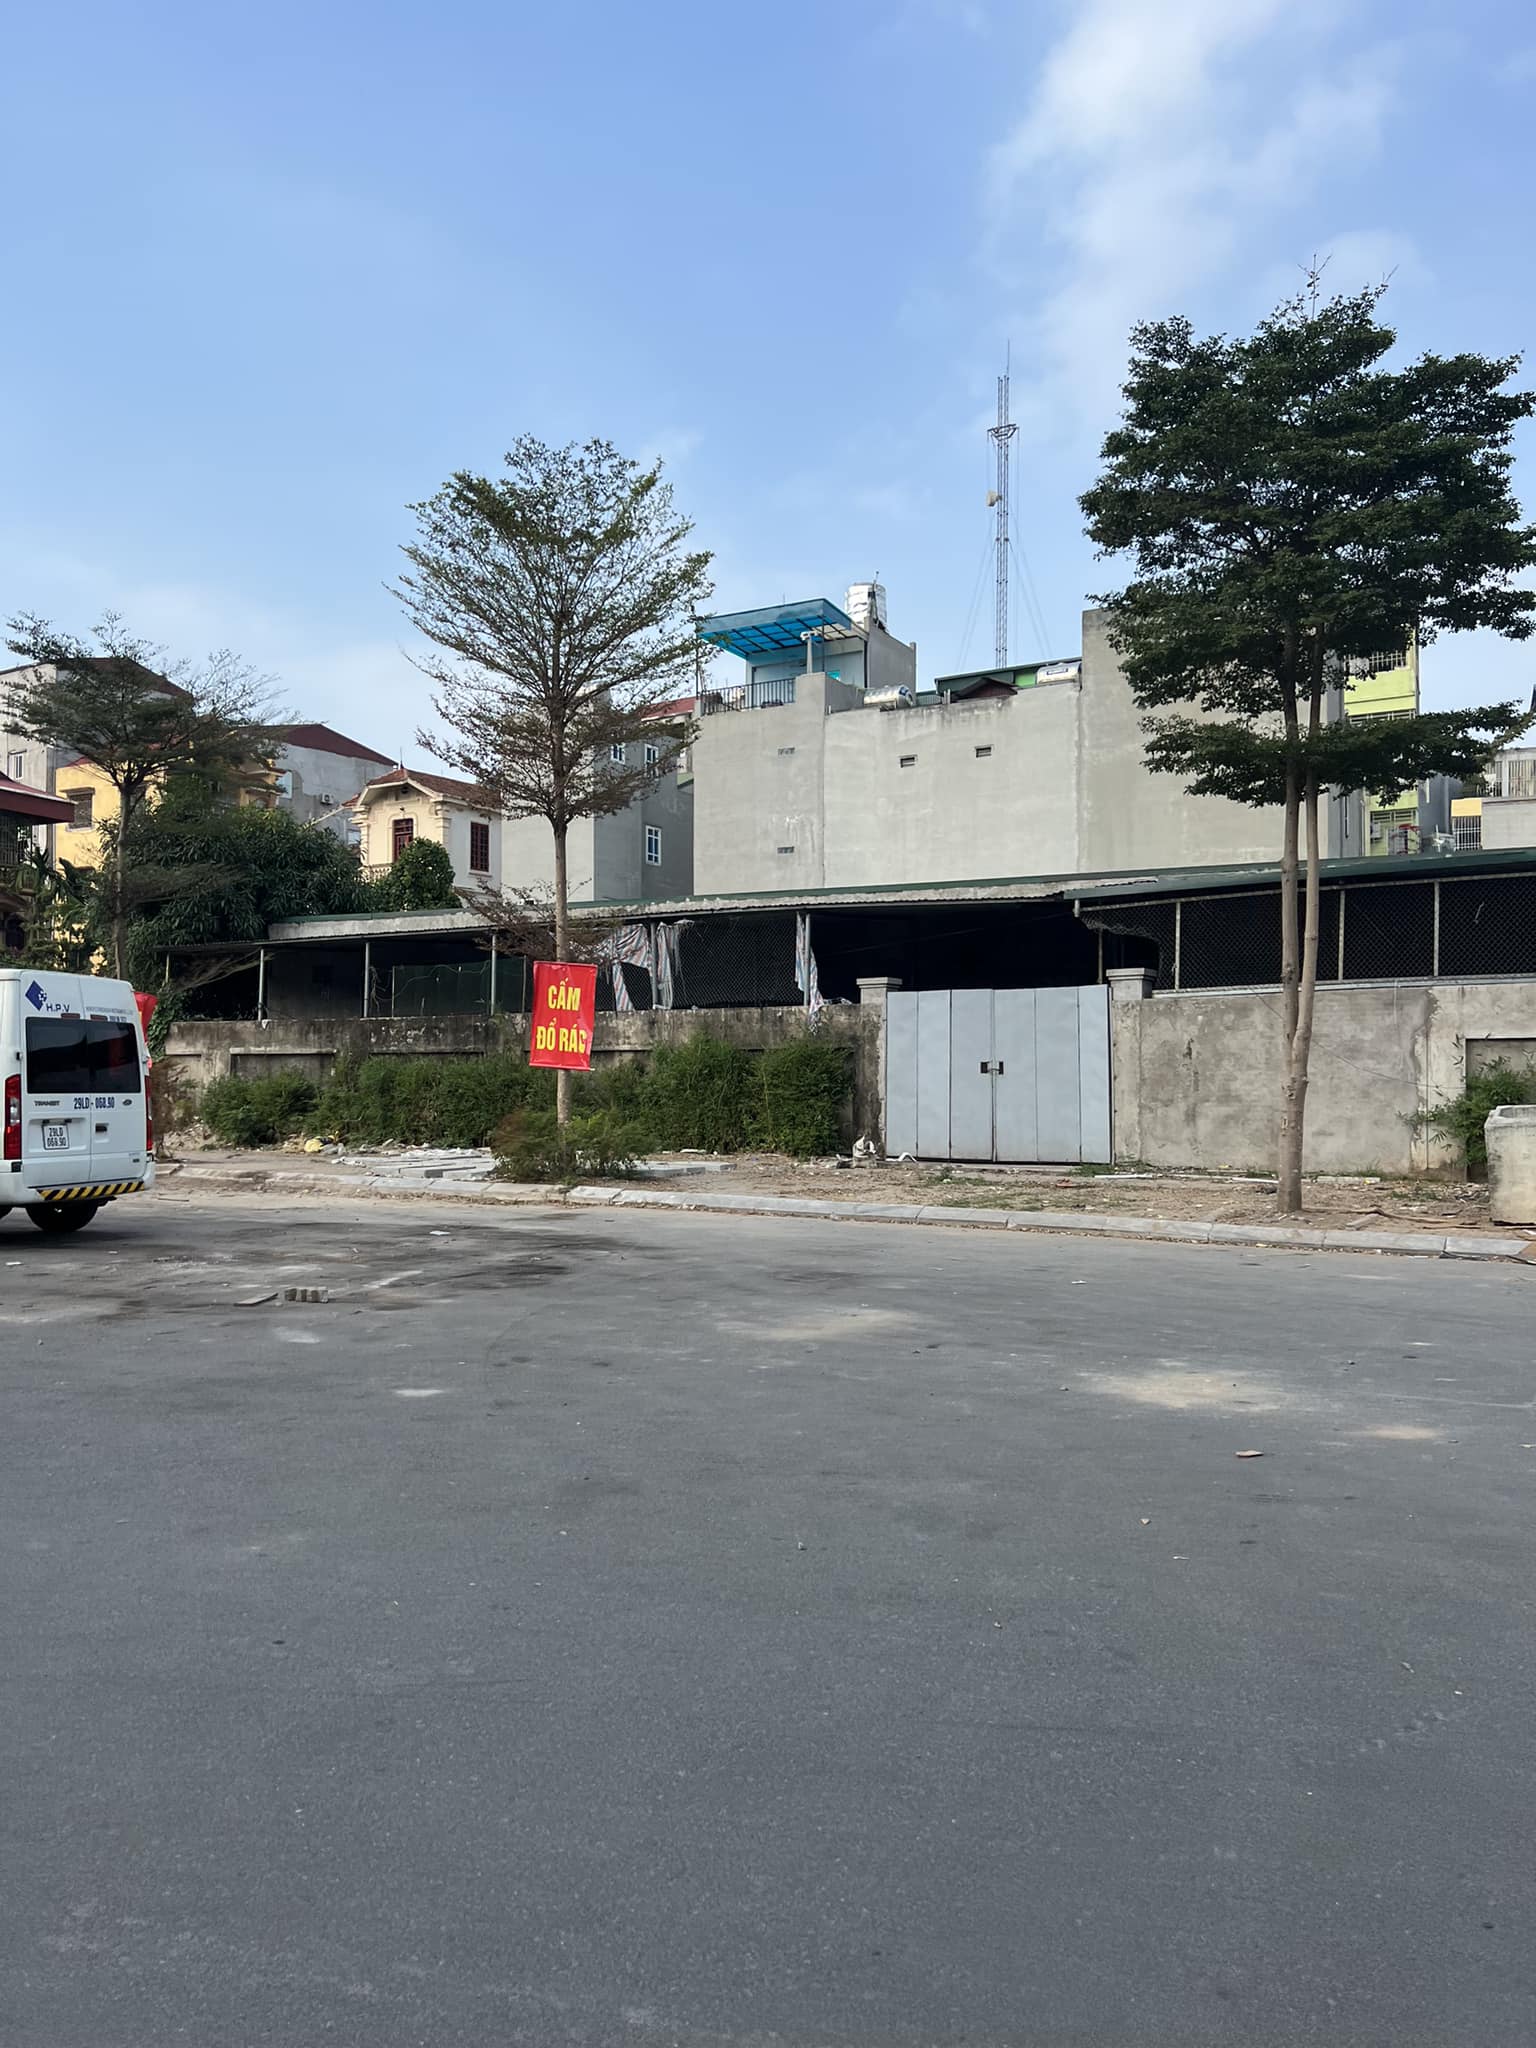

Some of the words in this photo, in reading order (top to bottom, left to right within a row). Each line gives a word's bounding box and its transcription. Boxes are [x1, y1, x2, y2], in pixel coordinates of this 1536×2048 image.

[548, 977, 581, 1011] CẤM
[536, 1017, 556, 1051] ĐỔ
[559, 1024, 587, 1054] RÁC
